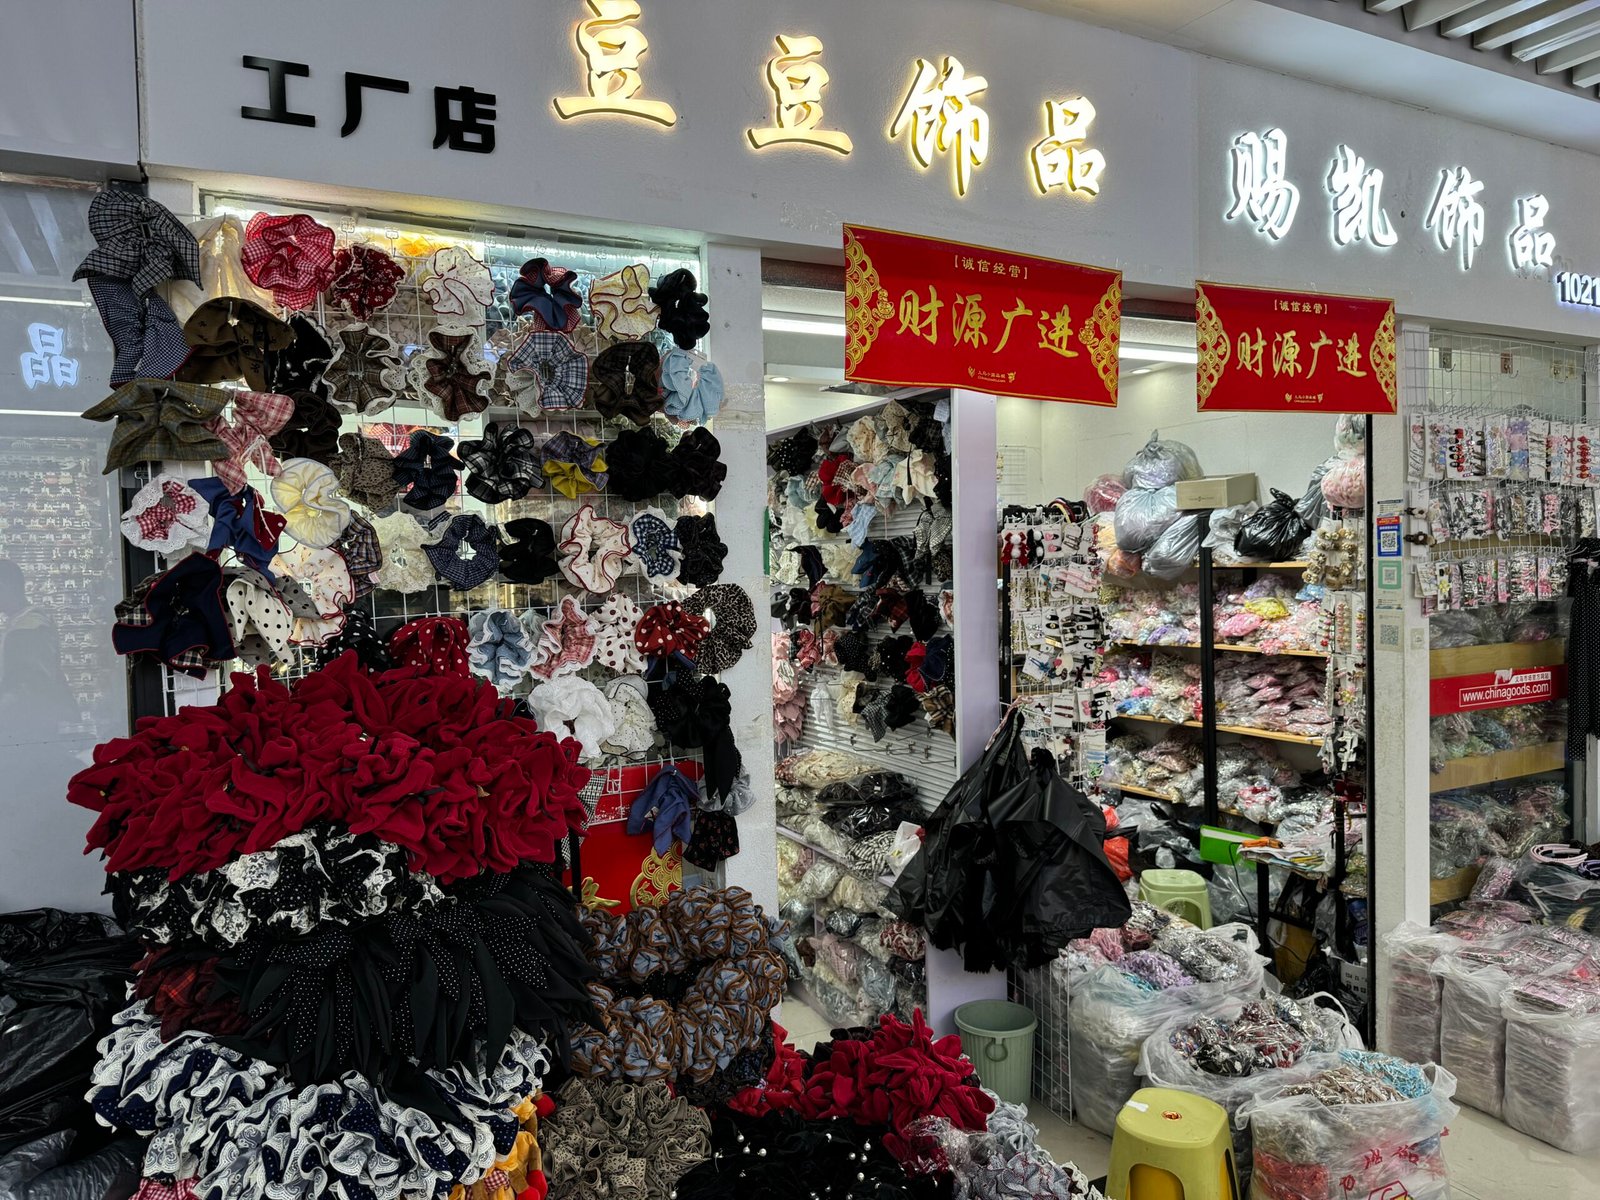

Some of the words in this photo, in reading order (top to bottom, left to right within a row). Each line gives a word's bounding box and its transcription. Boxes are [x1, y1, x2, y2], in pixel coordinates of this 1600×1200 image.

[241, 55, 497, 154] 工厂店
[1556, 271, 1600, 308] 1021
[896, 284, 1079, 358] 财源广进
[1236, 326, 1367, 379] 财源广进
[1462, 682, 1549, 703] www.chinagoods.com
